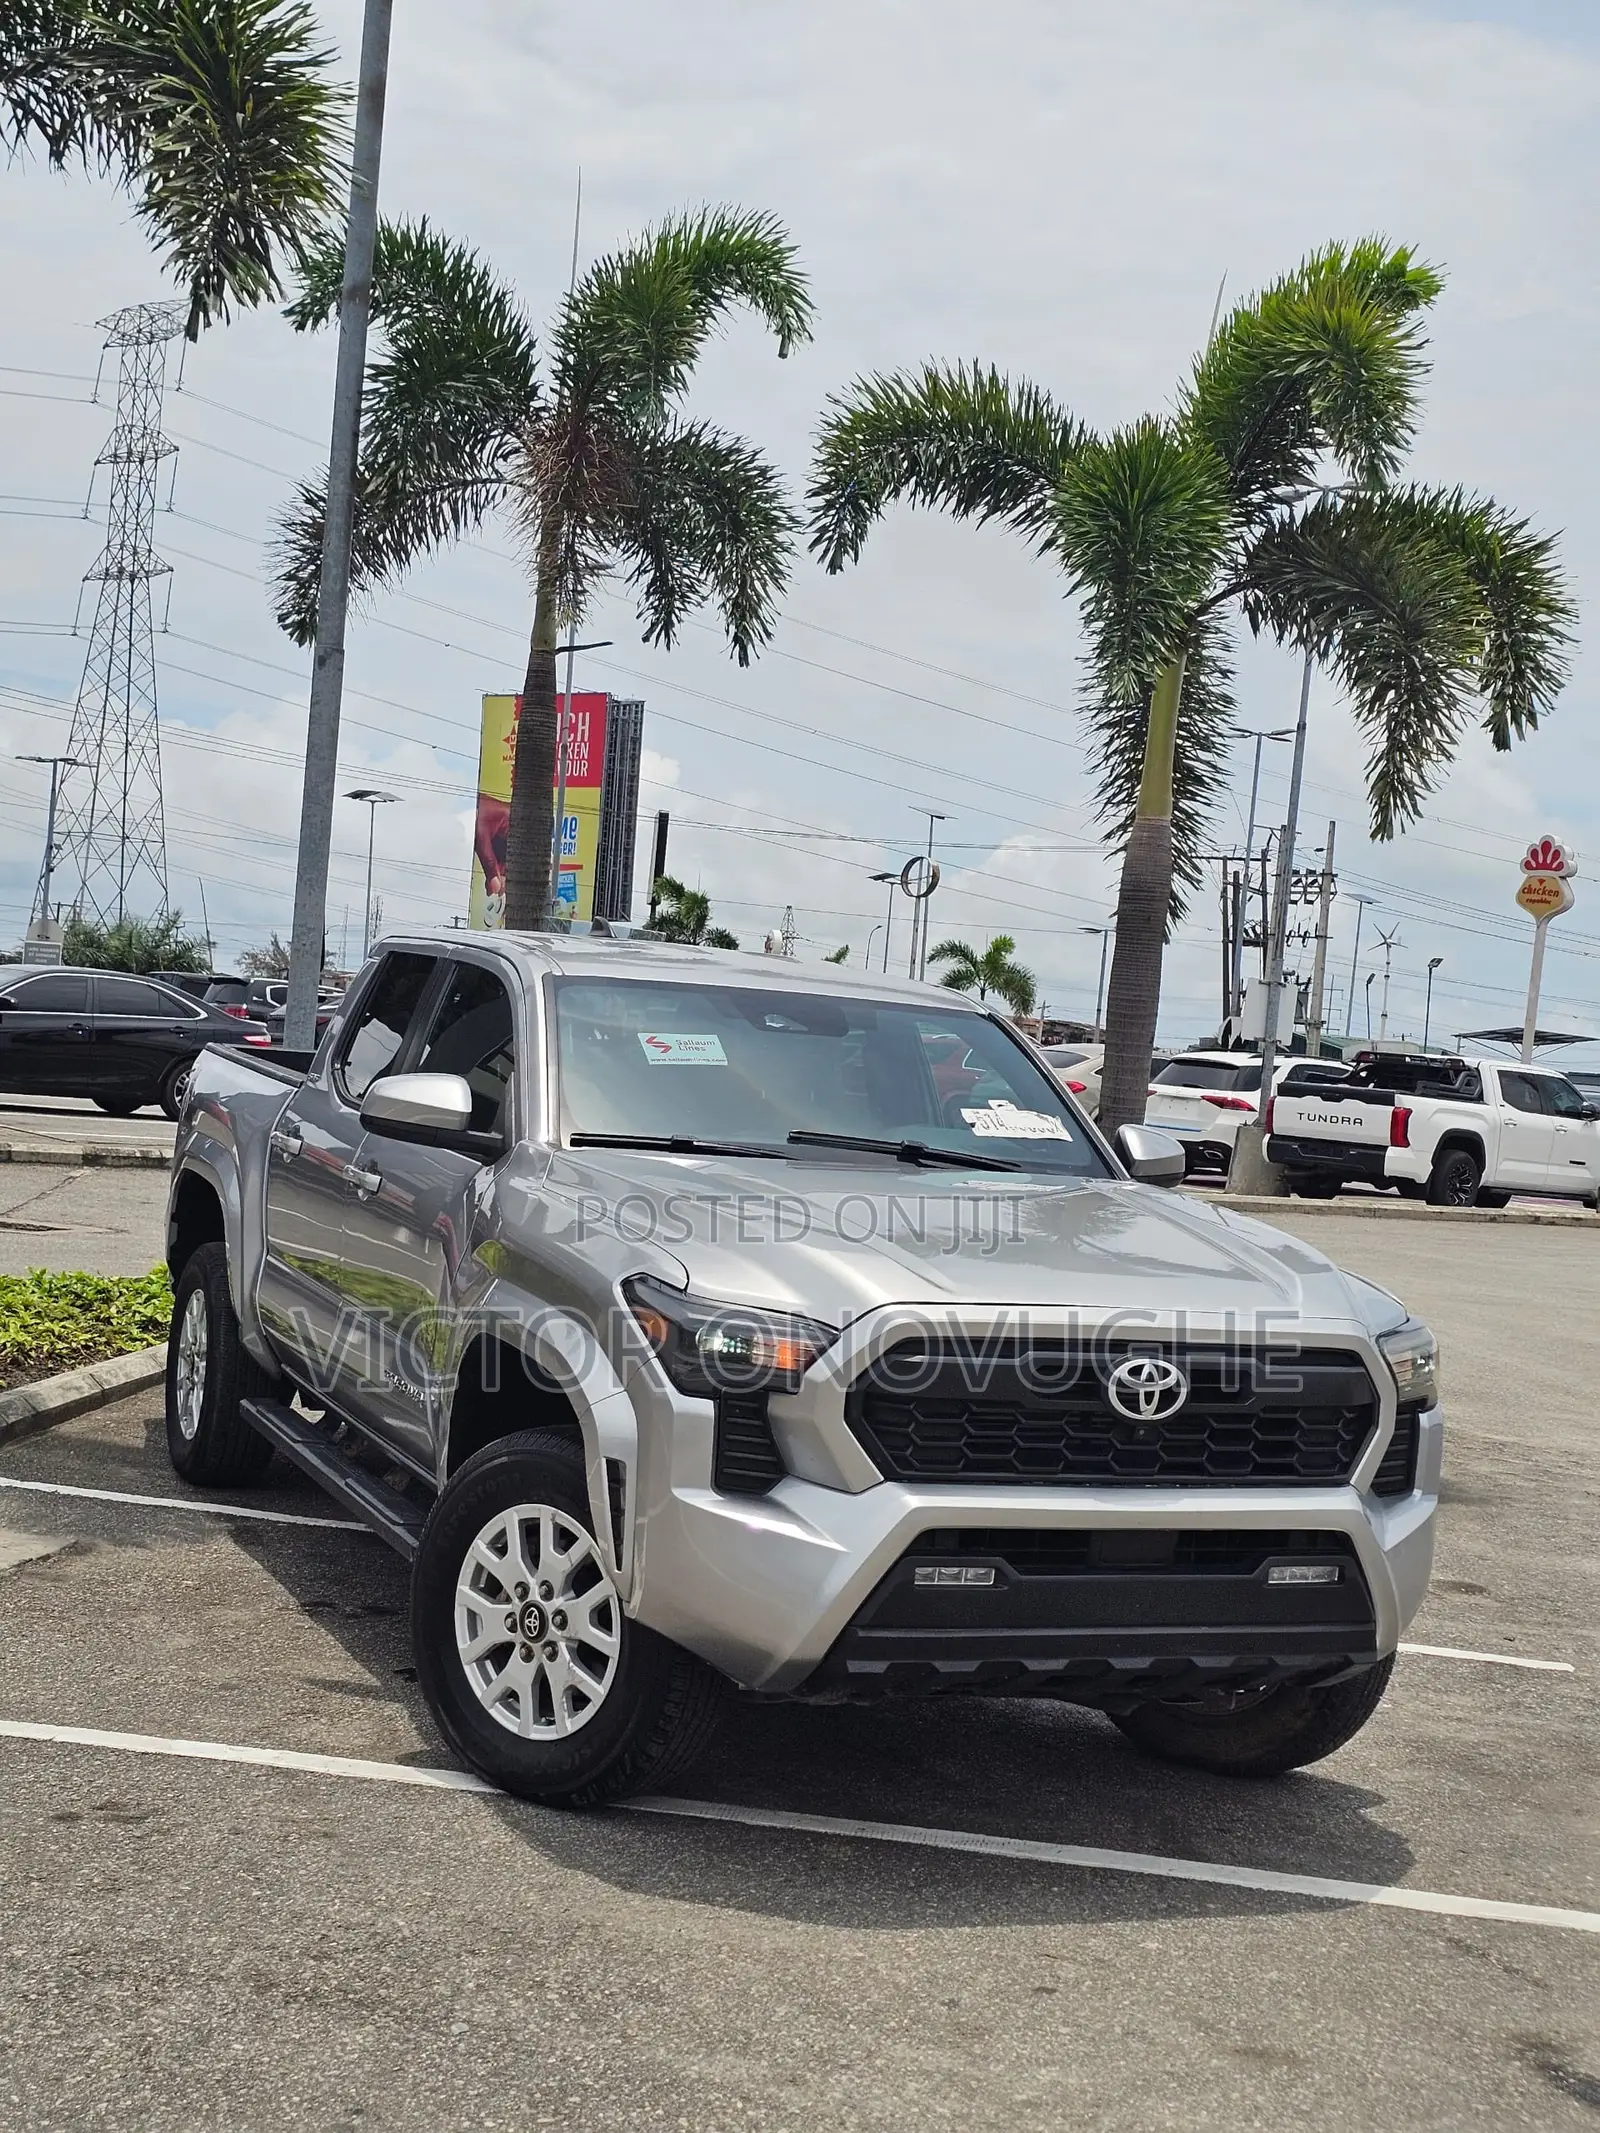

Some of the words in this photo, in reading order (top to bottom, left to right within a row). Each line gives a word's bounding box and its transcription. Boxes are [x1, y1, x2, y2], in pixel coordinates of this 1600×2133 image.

[556, 712, 590, 742] CH
[1521, 884, 1560, 898] chicken
[675, 1039, 716, 1047] Sallaum
[1297, 1112, 1363, 1127] TUNDRA
